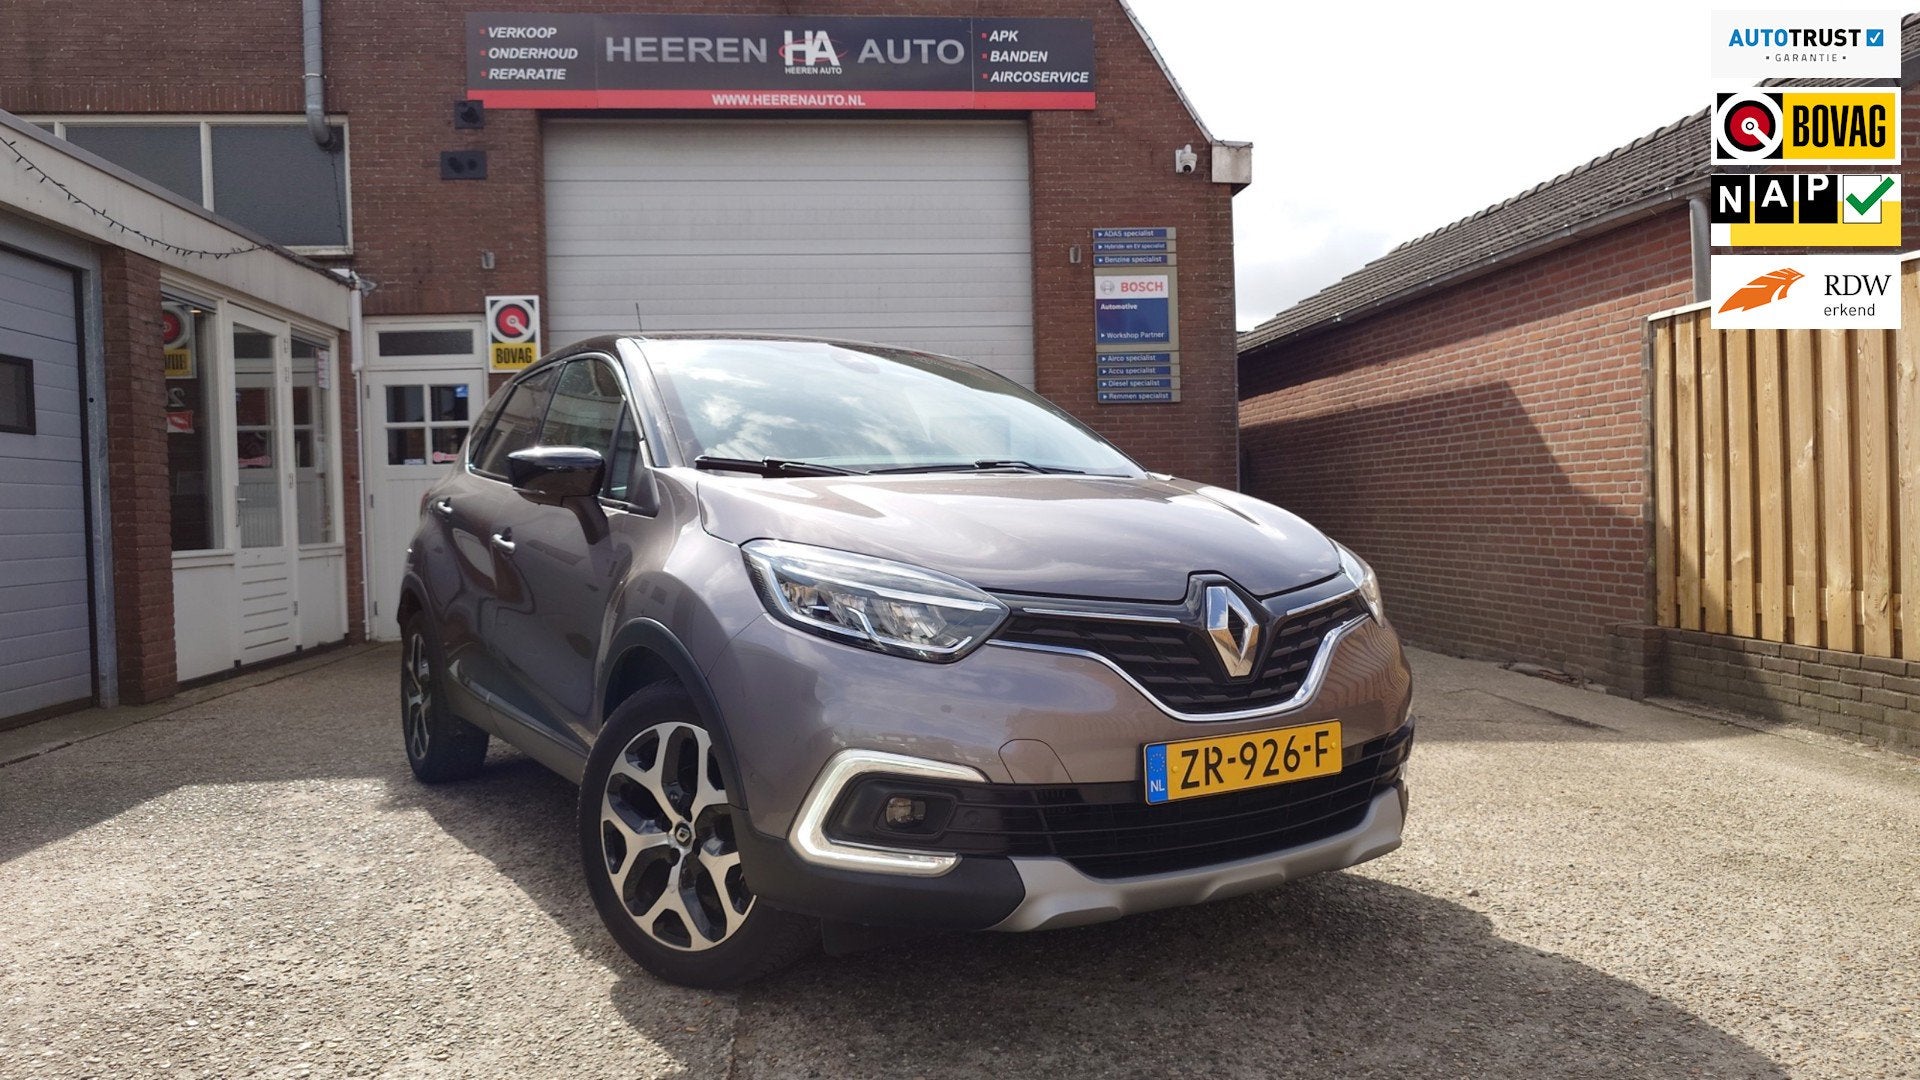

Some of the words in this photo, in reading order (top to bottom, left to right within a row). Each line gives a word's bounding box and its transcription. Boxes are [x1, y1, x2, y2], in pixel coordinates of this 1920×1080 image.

[488, 27, 557, 39] VERKOOP
[989, 30, 1019, 42] APK
[488, 47, 578, 60] ONDERHOUD
[605, 36, 768, 63] HEEREN
[856, 38, 965, 65] AUTO
[989, 51, 1048, 63] BANDEN
[488, 68, 566, 80] REPARATIE
[785, 67, 819, 75] HEEREN
[990, 71, 1089, 83] AIRCOSERVICE
[711, 94, 866, 106] WWW.HEERENAUTO.NL
[1123, 230, 1154, 238] specialist
[1131, 256, 1162, 264] specialist
[1120, 281, 1164, 293] BOSCH
[1106, 332, 1139, 340] Workshop
[495, 347, 532, 364] BOVAG
[1126, 354, 1156, 362] specialist
[1125, 367, 1156, 375] specialist
[1129, 379, 1160, 388] specialist
[1138, 392, 1169, 400] specialist
[1180, 730, 1330, 790] ZR-926-F
[1150, 780, 1166, 793] NL
